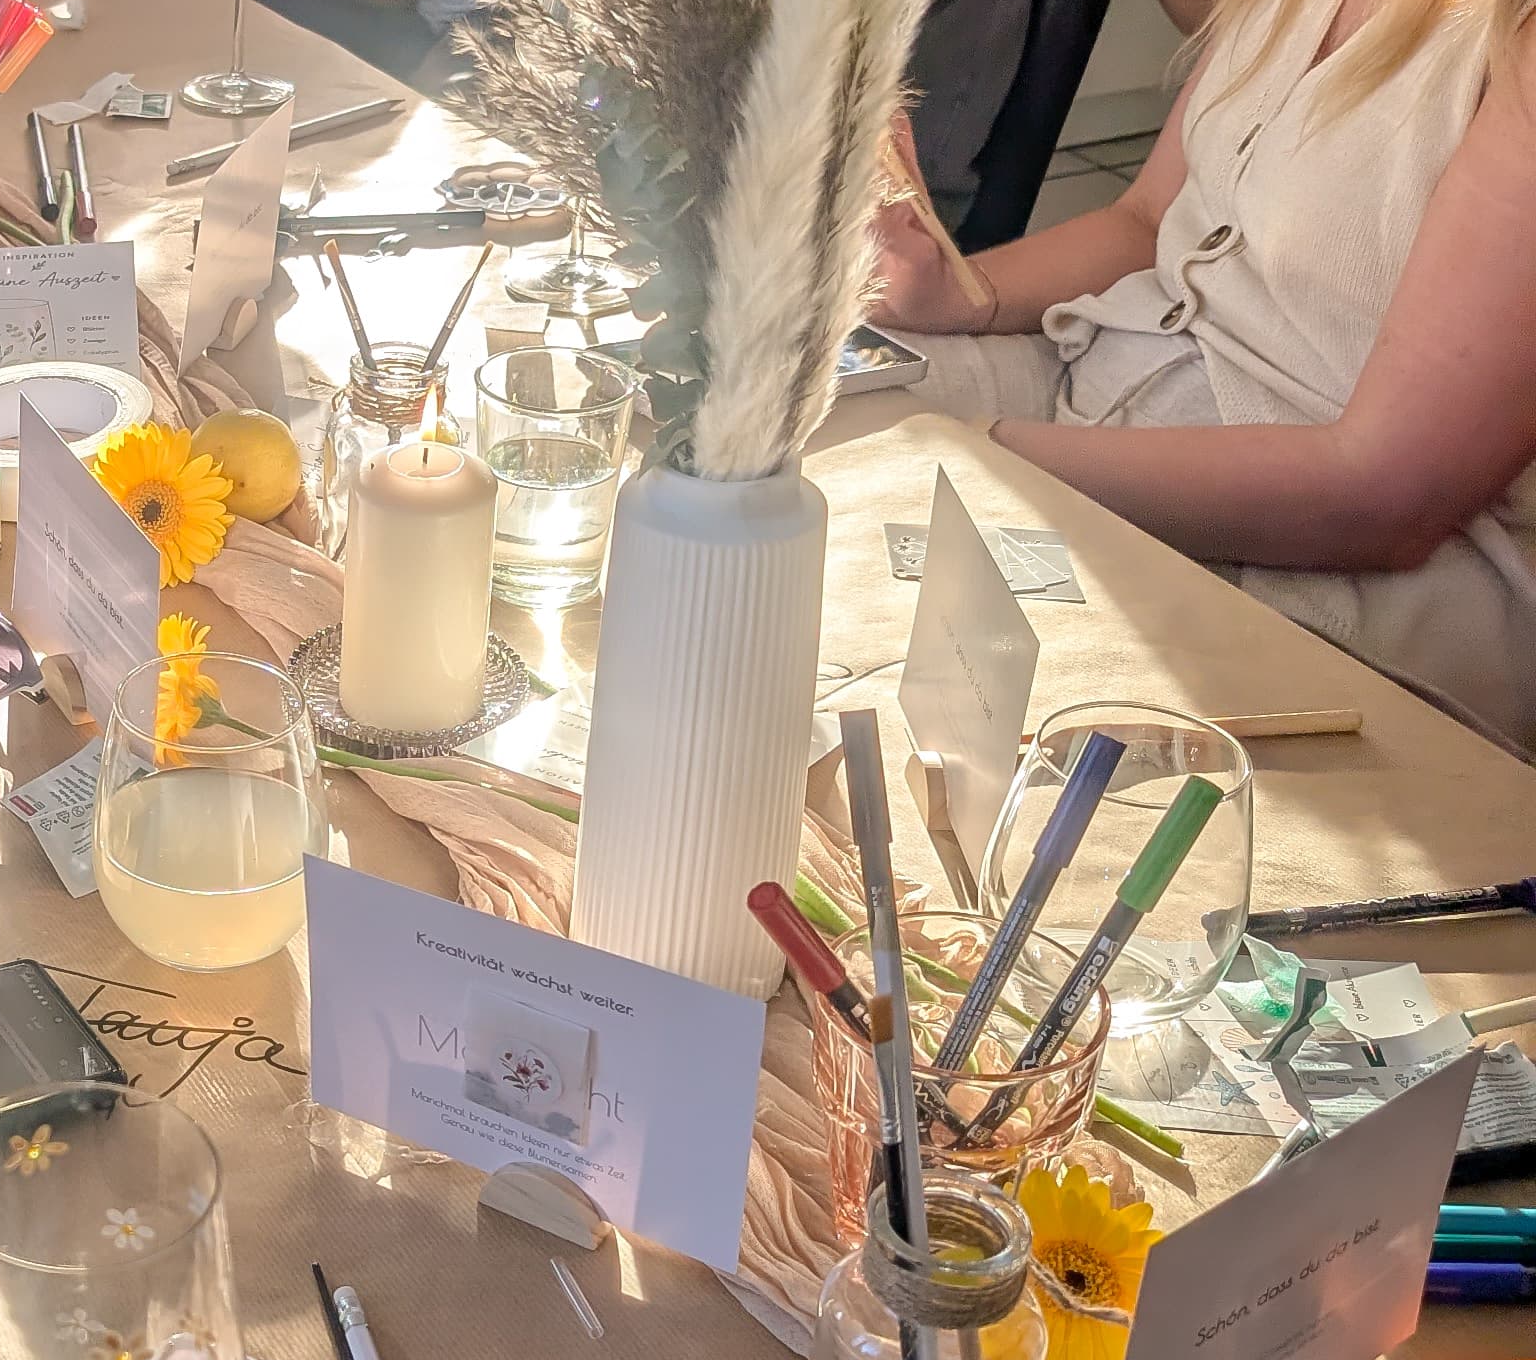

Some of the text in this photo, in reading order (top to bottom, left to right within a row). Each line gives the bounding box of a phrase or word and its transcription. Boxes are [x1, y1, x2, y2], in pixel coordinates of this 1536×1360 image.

[3, 252, 75, 261] INSPIRATION
[39, 271, 110, 289] Auszeit
[68, 556, 83, 580] dass
[86, 577, 95, 593] du
[97, 591, 107, 610] da
[416, 931, 635, 1017] Kreativität wächst weiter.
[1059, 950, 1108, 1015] edding
[411, 1088, 465, 1118] Manchmal
[469, 1112, 518, 1139] brauchen
[522, 1131, 550, 1151] Ideen
[554, 1145, 570, 1158] nur
[575, 1155, 604, 1172] etwas
[441, 1114, 475, 1134] Genau
[478, 1131, 495, 1143] wie
[499, 1138, 524, 1154] diese
[1257, 1277, 1294, 1307] dass
[1299, 1258, 1320, 1279] du
[1326, 1241, 1348, 1263] da
